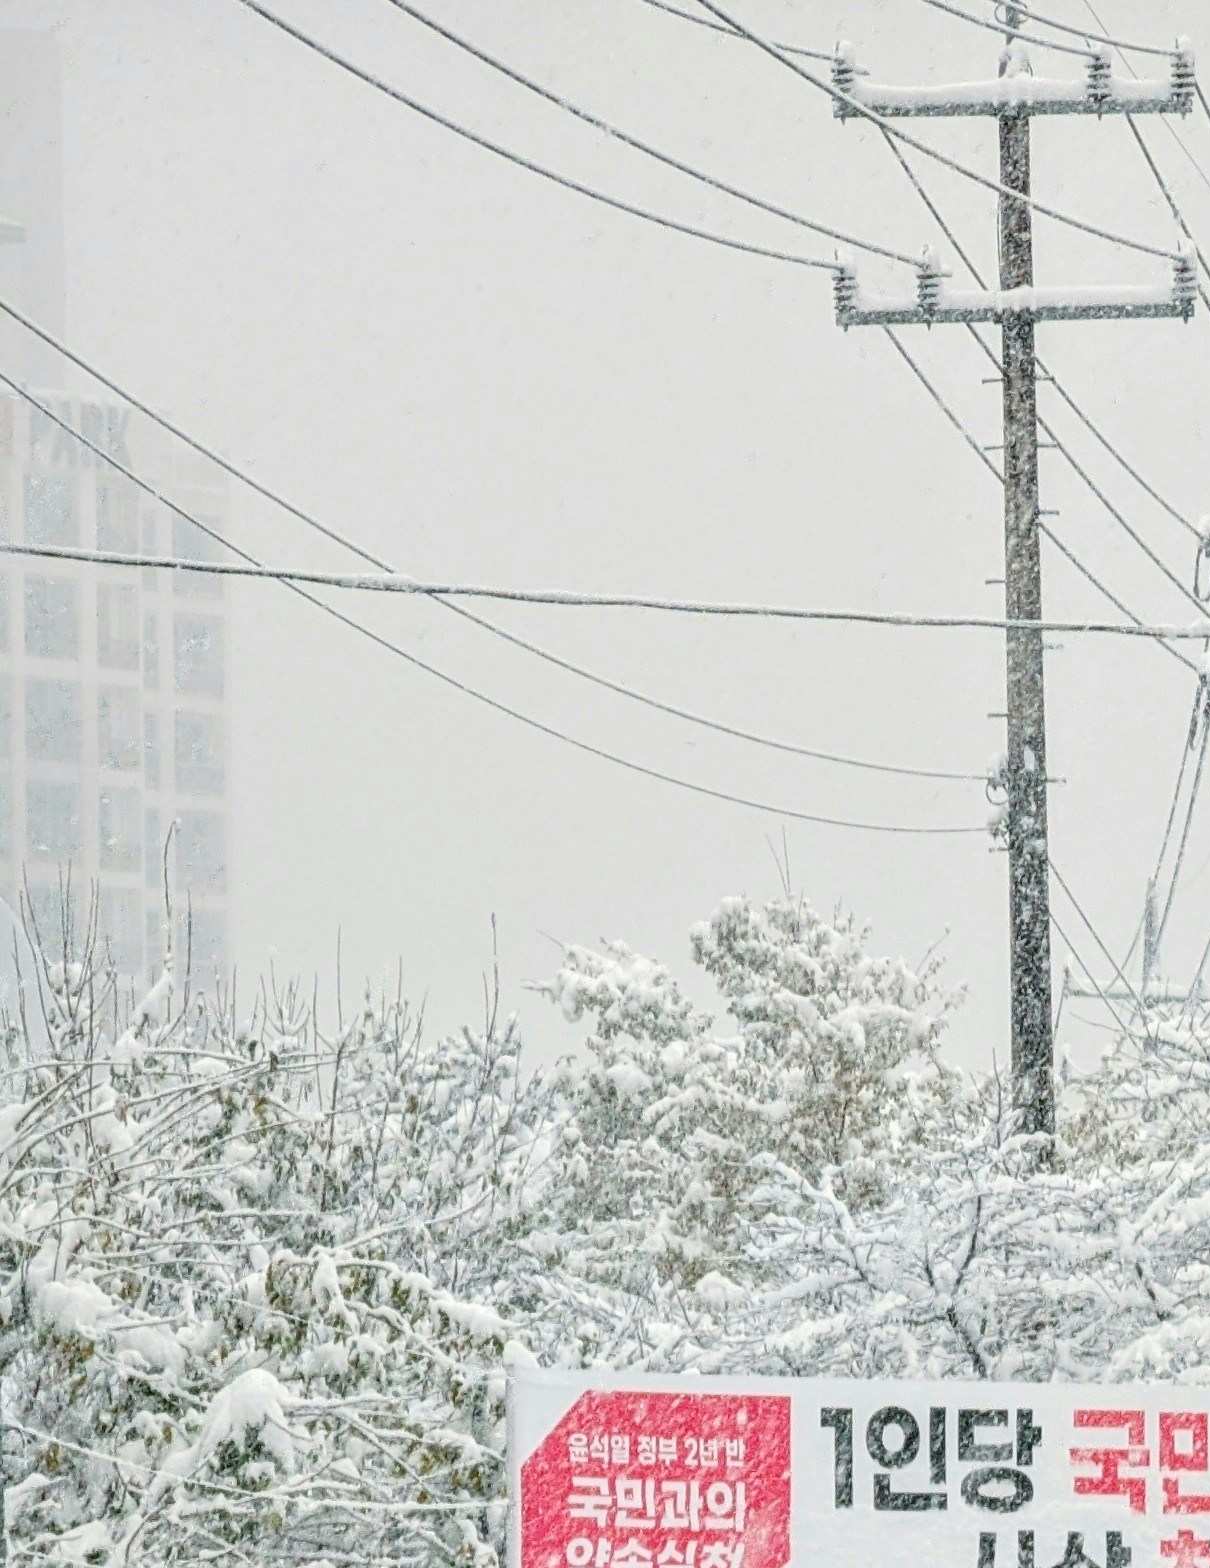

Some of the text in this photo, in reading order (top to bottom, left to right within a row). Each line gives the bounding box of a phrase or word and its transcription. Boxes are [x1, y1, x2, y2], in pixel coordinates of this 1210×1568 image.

[569, 1433, 746, 1468] 윤석열 정부 2년 반
[820, 1405, 1042, 1514] 1인당
[568, 1476, 746, 1532] 국민과의
